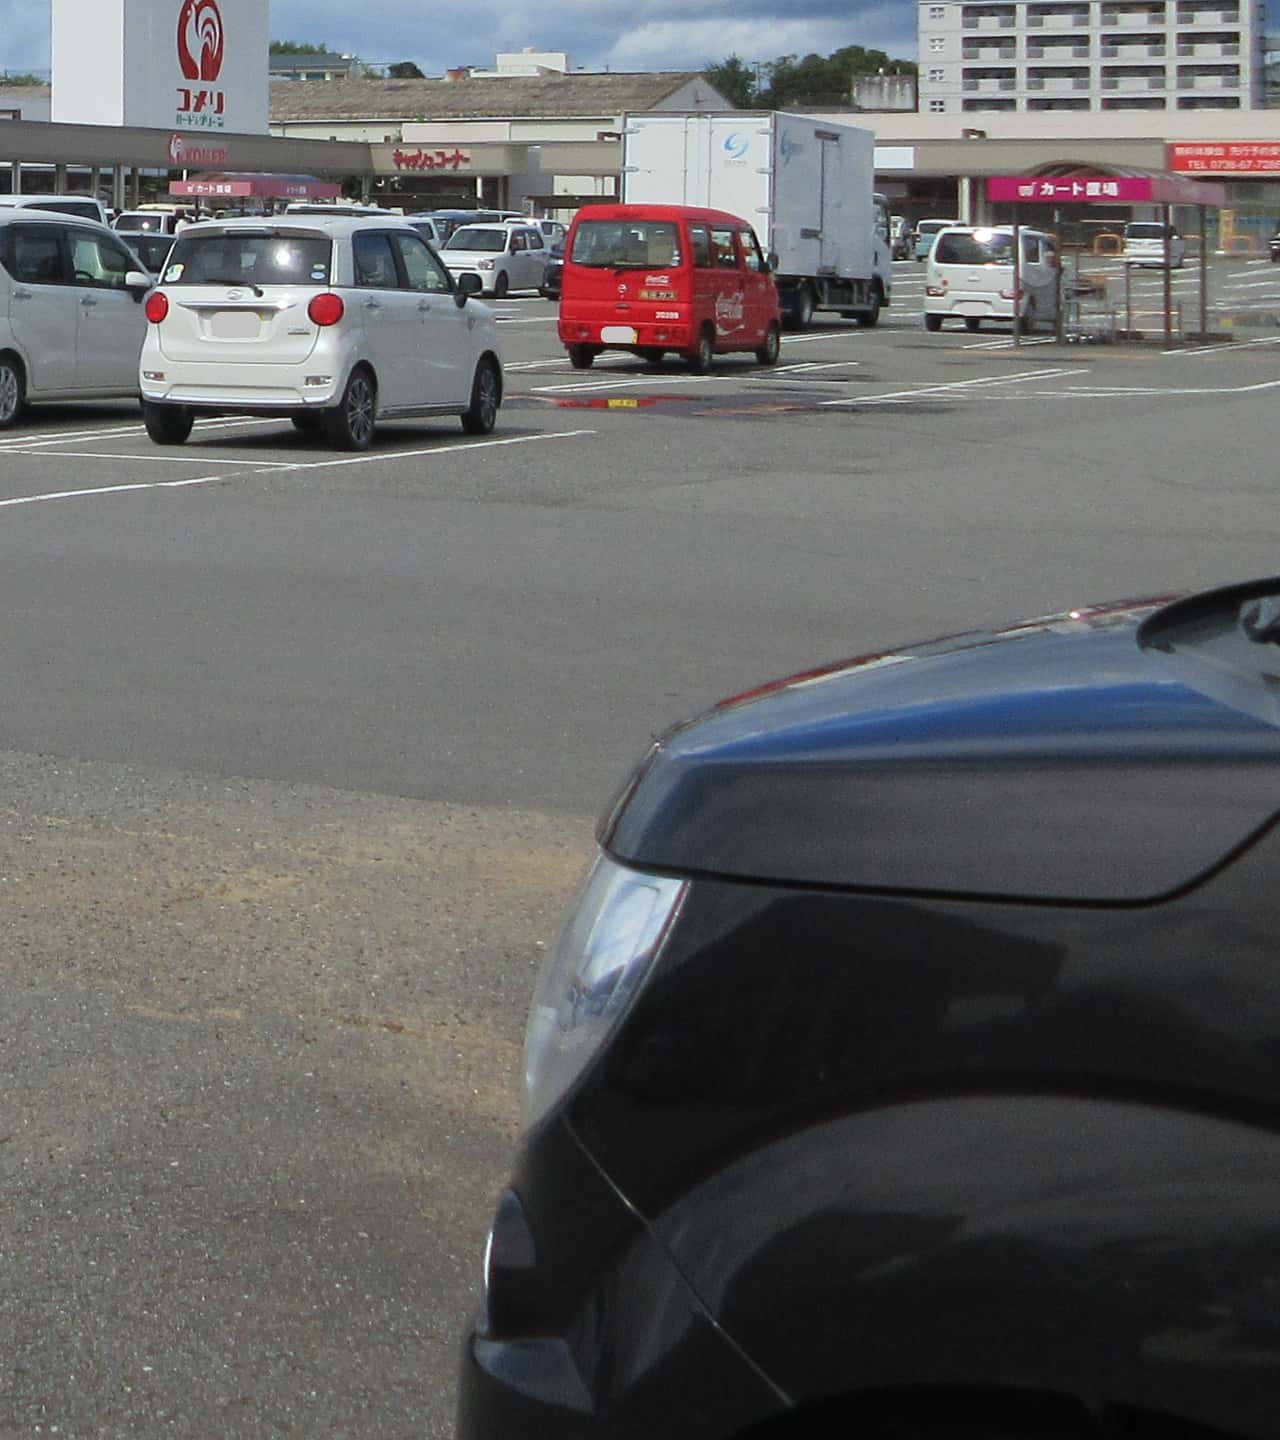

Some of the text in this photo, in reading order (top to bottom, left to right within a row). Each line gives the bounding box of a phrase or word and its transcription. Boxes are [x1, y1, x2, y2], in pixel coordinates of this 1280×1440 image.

[176, 88, 225, 114] コメリ
[1188, 161, 1208, 169] TEL
[1040, 182, 1120, 197] カート置場
